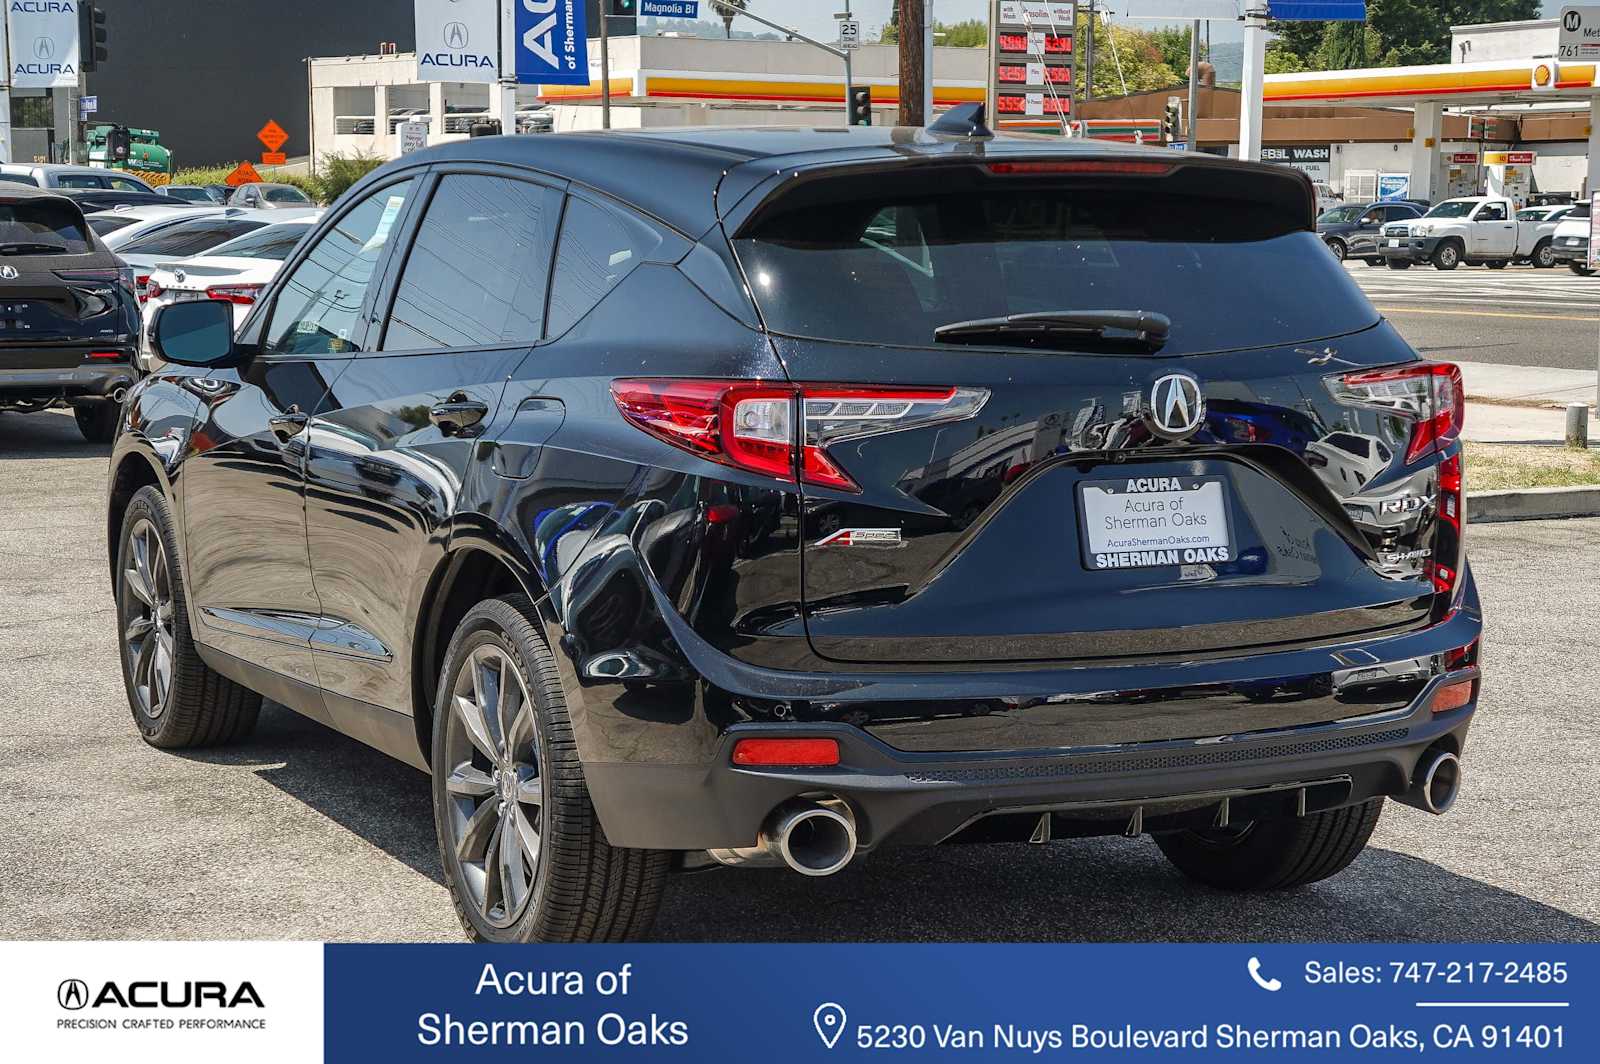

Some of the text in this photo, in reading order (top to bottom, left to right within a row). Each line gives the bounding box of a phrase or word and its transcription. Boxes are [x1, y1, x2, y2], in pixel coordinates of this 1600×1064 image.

[11, 2, 74, 13] ACURA
[644, 2, 695, 15] Magnolia Bl
[841, 24, 857, 35] 25
[1560, 45, 1578, 57] 761
[421, 53, 495, 68] ACURA
[564, 55, 577, 70] of
[15, 63, 75, 75] ACURA
[1293, 148, 1329, 159] WASH
[1126, 478, 1182, 493] ACURA
[1125, 496, 1184, 513] Acura of
[1382, 495, 1436, 514] RDX
[1105, 512, 1208, 530] Sherman Oaks
[1107, 535, 1210, 548] AcuraShermanOaks.com
[1096, 547, 1229, 569] SHERMAN OAKS
